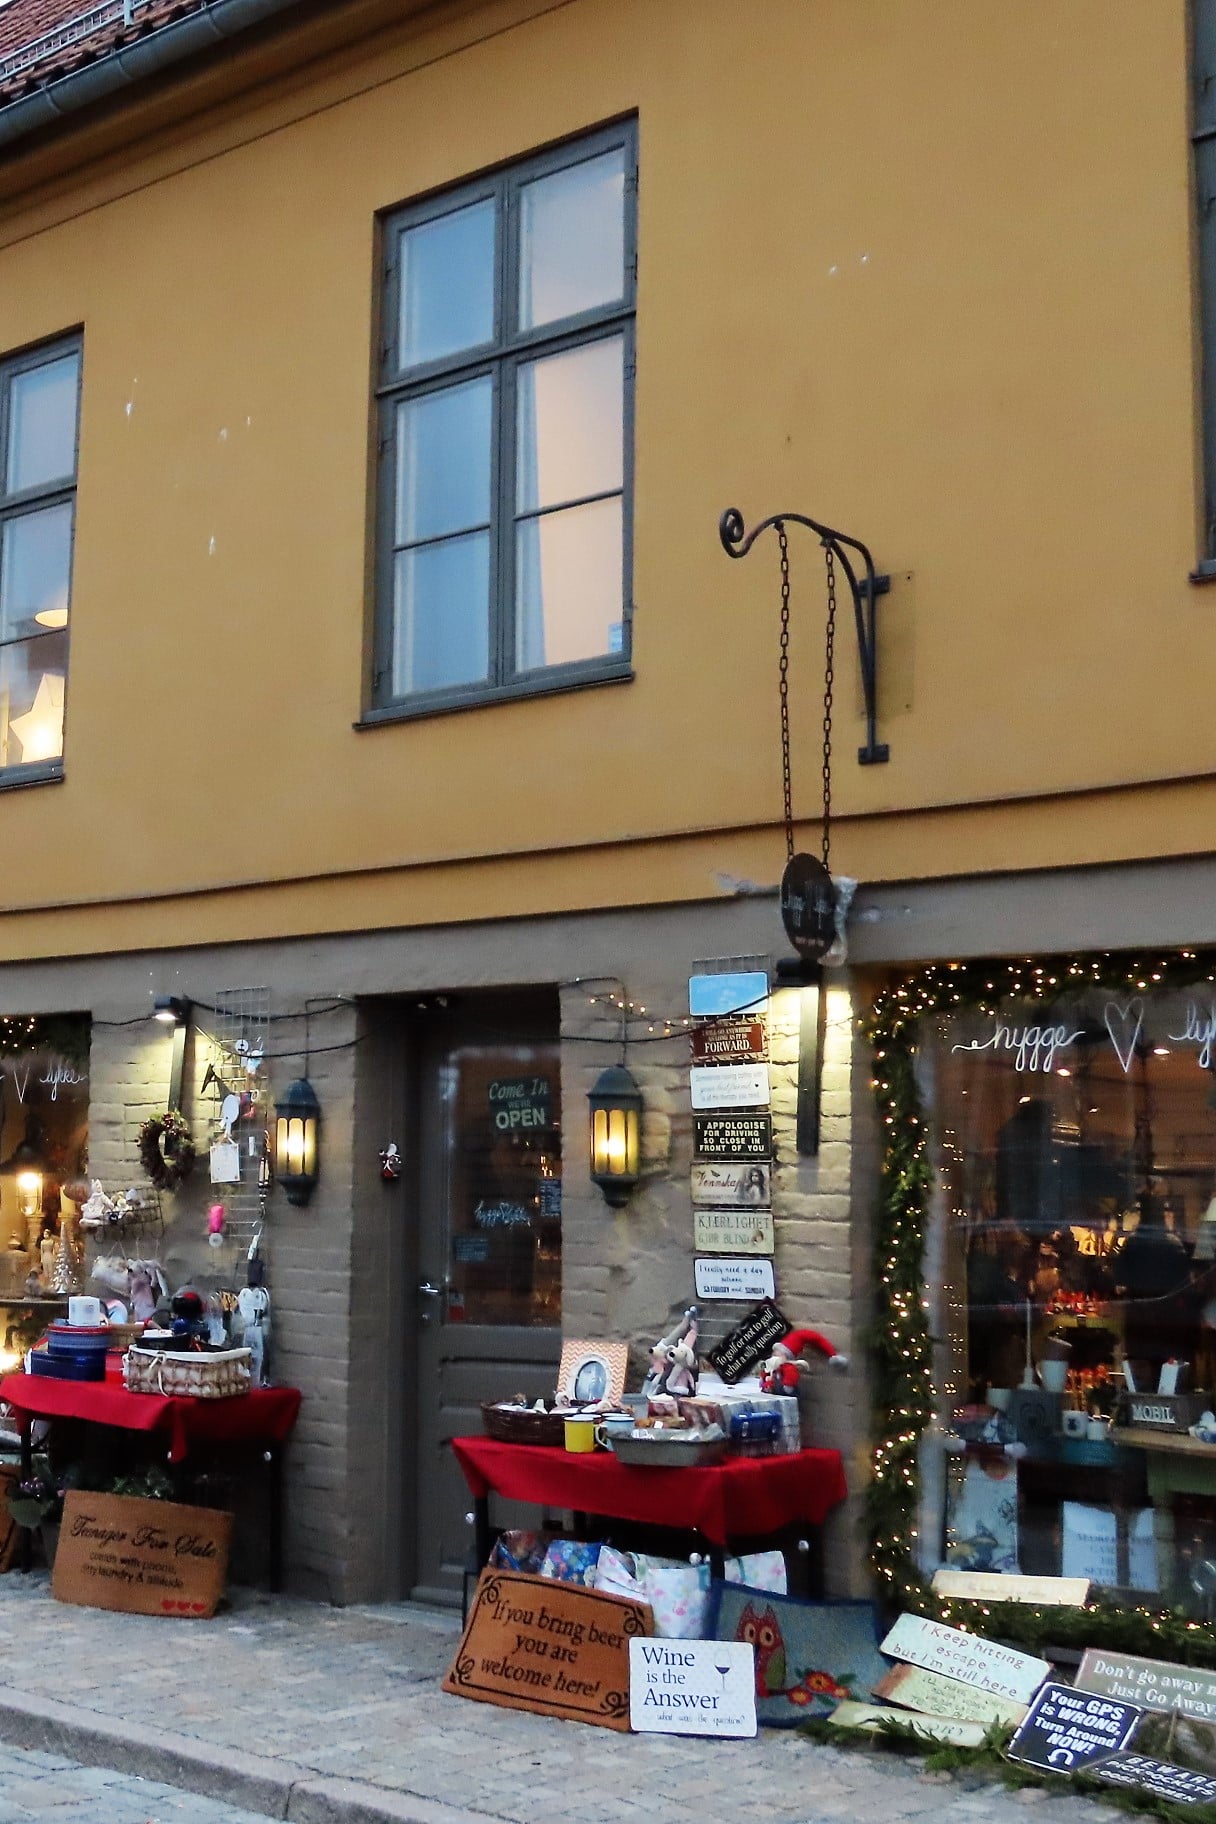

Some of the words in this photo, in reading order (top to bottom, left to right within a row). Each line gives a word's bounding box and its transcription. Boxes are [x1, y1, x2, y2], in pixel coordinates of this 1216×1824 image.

[704, 1039, 752, 1053] FORWARD.
[952, 1022, 1086, 1072] hygge
[489, 1082, 524, 1100] Come
[531, 1079, 549, 1095] In
[496, 1108, 545, 1129] OPEN
[697, 1122, 700, 1130] I
[706, 1121, 766, 1130] APPOLOGISE
[699, 1144, 726, 1152] FRONT
[731, 1144, 742, 1152] OF
[747, 1144, 764, 1152] YOU
[725, 1265, 739, 1273] need
[751, 1266, 763, 1275] day
[716, 1354, 726, 1366] To
[725, 1342, 739, 1362] golf
[736, 1336, 745, 1348] or
[743, 1327, 756, 1342] not
[753, 1322, 762, 1332] to
[760, 1308, 774, 1327] golf
[725, 1359, 742, 1377] what
[744, 1343, 758, 1358] silly
[755, 1321, 783, 1348] question
[1131, 1403, 1176, 1424] MOBIL
[71, 1514, 127, 1549] Teenager
[131, 1526, 169, 1549] For
[174, 1534, 216, 1558] Sale
[99, 1566, 134, 1583] laundry
[136, 1572, 144, 1582] &
[492, 1600, 510, 1620] If
[504, 1608, 534, 1627] you
[538, 1606, 585, 1647] bring
[588, 1621, 625, 1650] beer
[511, 1634, 548, 1655] you
[550, 1645, 578, 1665] are
[641, 1646, 695, 1667] Wine
[921, 1622, 928, 1633] I
[930, 1625, 969, 1648] Keep
[974, 1641, 1025, 1670] hitting
[480, 1656, 552, 1687] welcome
[553, 1671, 602, 1698] here!
[646, 1669, 658, 1683] is
[662, 1668, 686, 1685] the
[893, 1643, 917, 1659] but
[948, 1664, 979, 1684] still
[981, 1673, 1018, 1698] here
[1093, 1659, 1134, 1680] Don't
[1137, 1668, 1157, 1685] go
[1161, 1674, 1204, 1695] away
[643, 1688, 720, 1709] Answer
[1050, 1690, 1085, 1710] Your
[1086, 1700, 1125, 1720] GPS
[1107, 1682, 1141, 1702] Just
[1145, 1688, 1167, 1704] Go
[1034, 1716, 1066, 1734] Turn
[1067, 1726, 1117, 1748] Around
[1040, 1702, 1056, 1717] is
[1057, 1707, 1122, 1737] WRONG,
[1046, 1732, 1096, 1756] NOW!
[1094, 1766, 1134, 1784] OOSE
[1140, 1782, 1196, 1803] WOMEN
[1125, 1756, 1216, 1789] BEWARE
